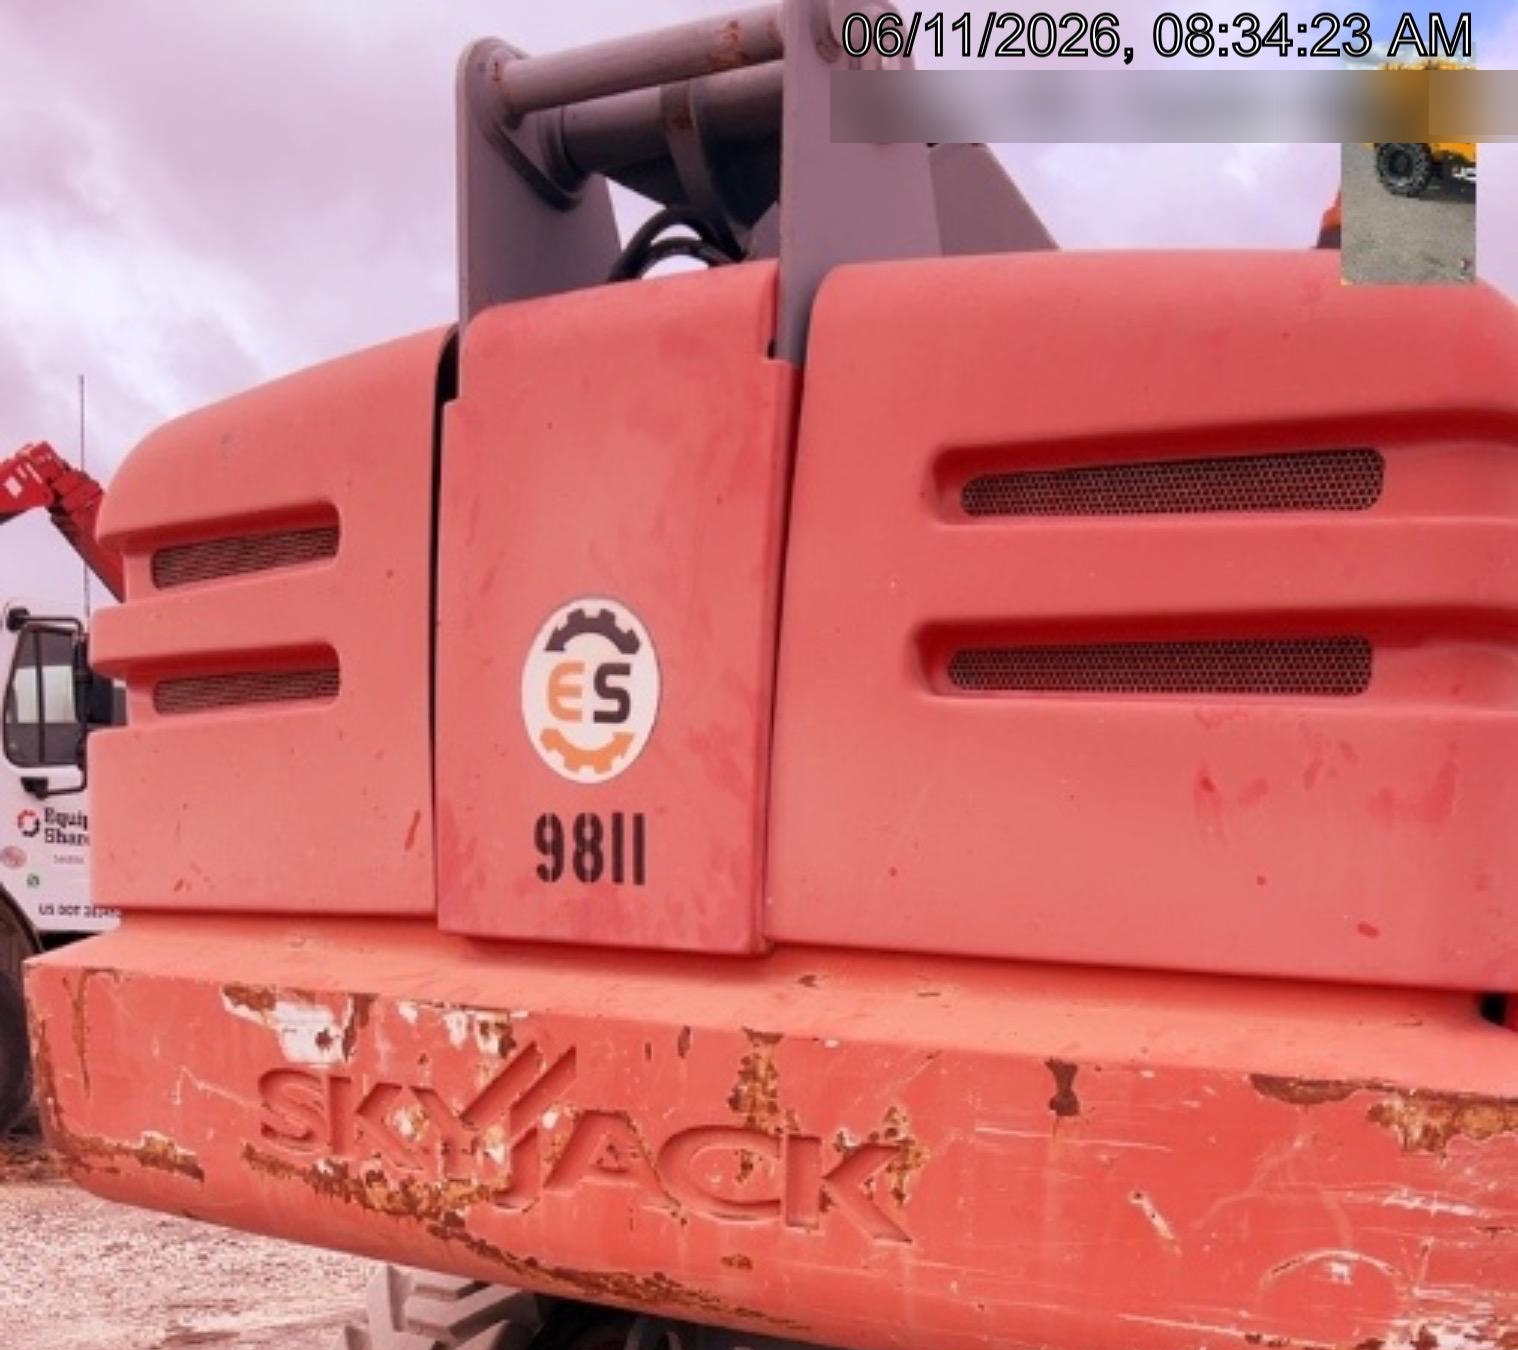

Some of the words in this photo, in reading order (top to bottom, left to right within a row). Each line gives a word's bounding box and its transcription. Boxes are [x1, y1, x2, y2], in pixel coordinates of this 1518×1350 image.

[546, 661, 632, 724] ES
[533, 811, 646, 886] 9811
[257, 1039, 912, 1244] SKYJACK
